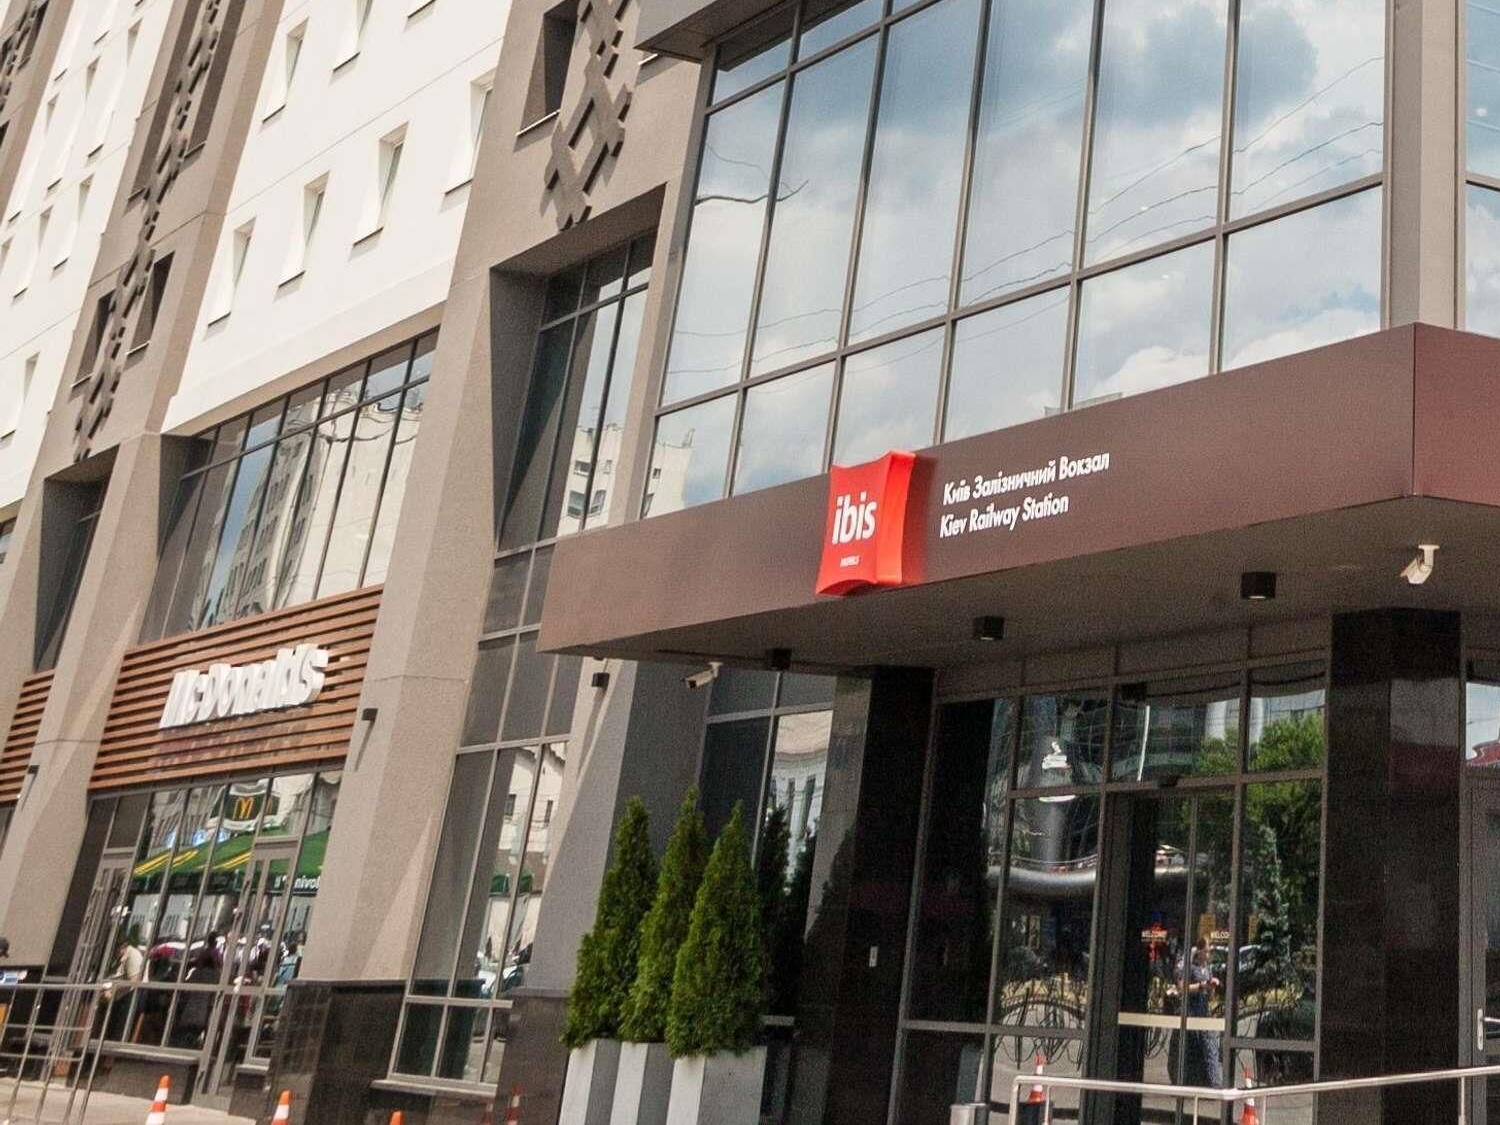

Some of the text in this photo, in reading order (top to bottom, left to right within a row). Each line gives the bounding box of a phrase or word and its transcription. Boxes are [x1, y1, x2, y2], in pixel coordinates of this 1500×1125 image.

[943, 452, 1110, 506] Київ Залізничний Вокзал
[832, 491, 877, 545] ibis
[939, 492, 1070, 539] Kiev Railway Station
